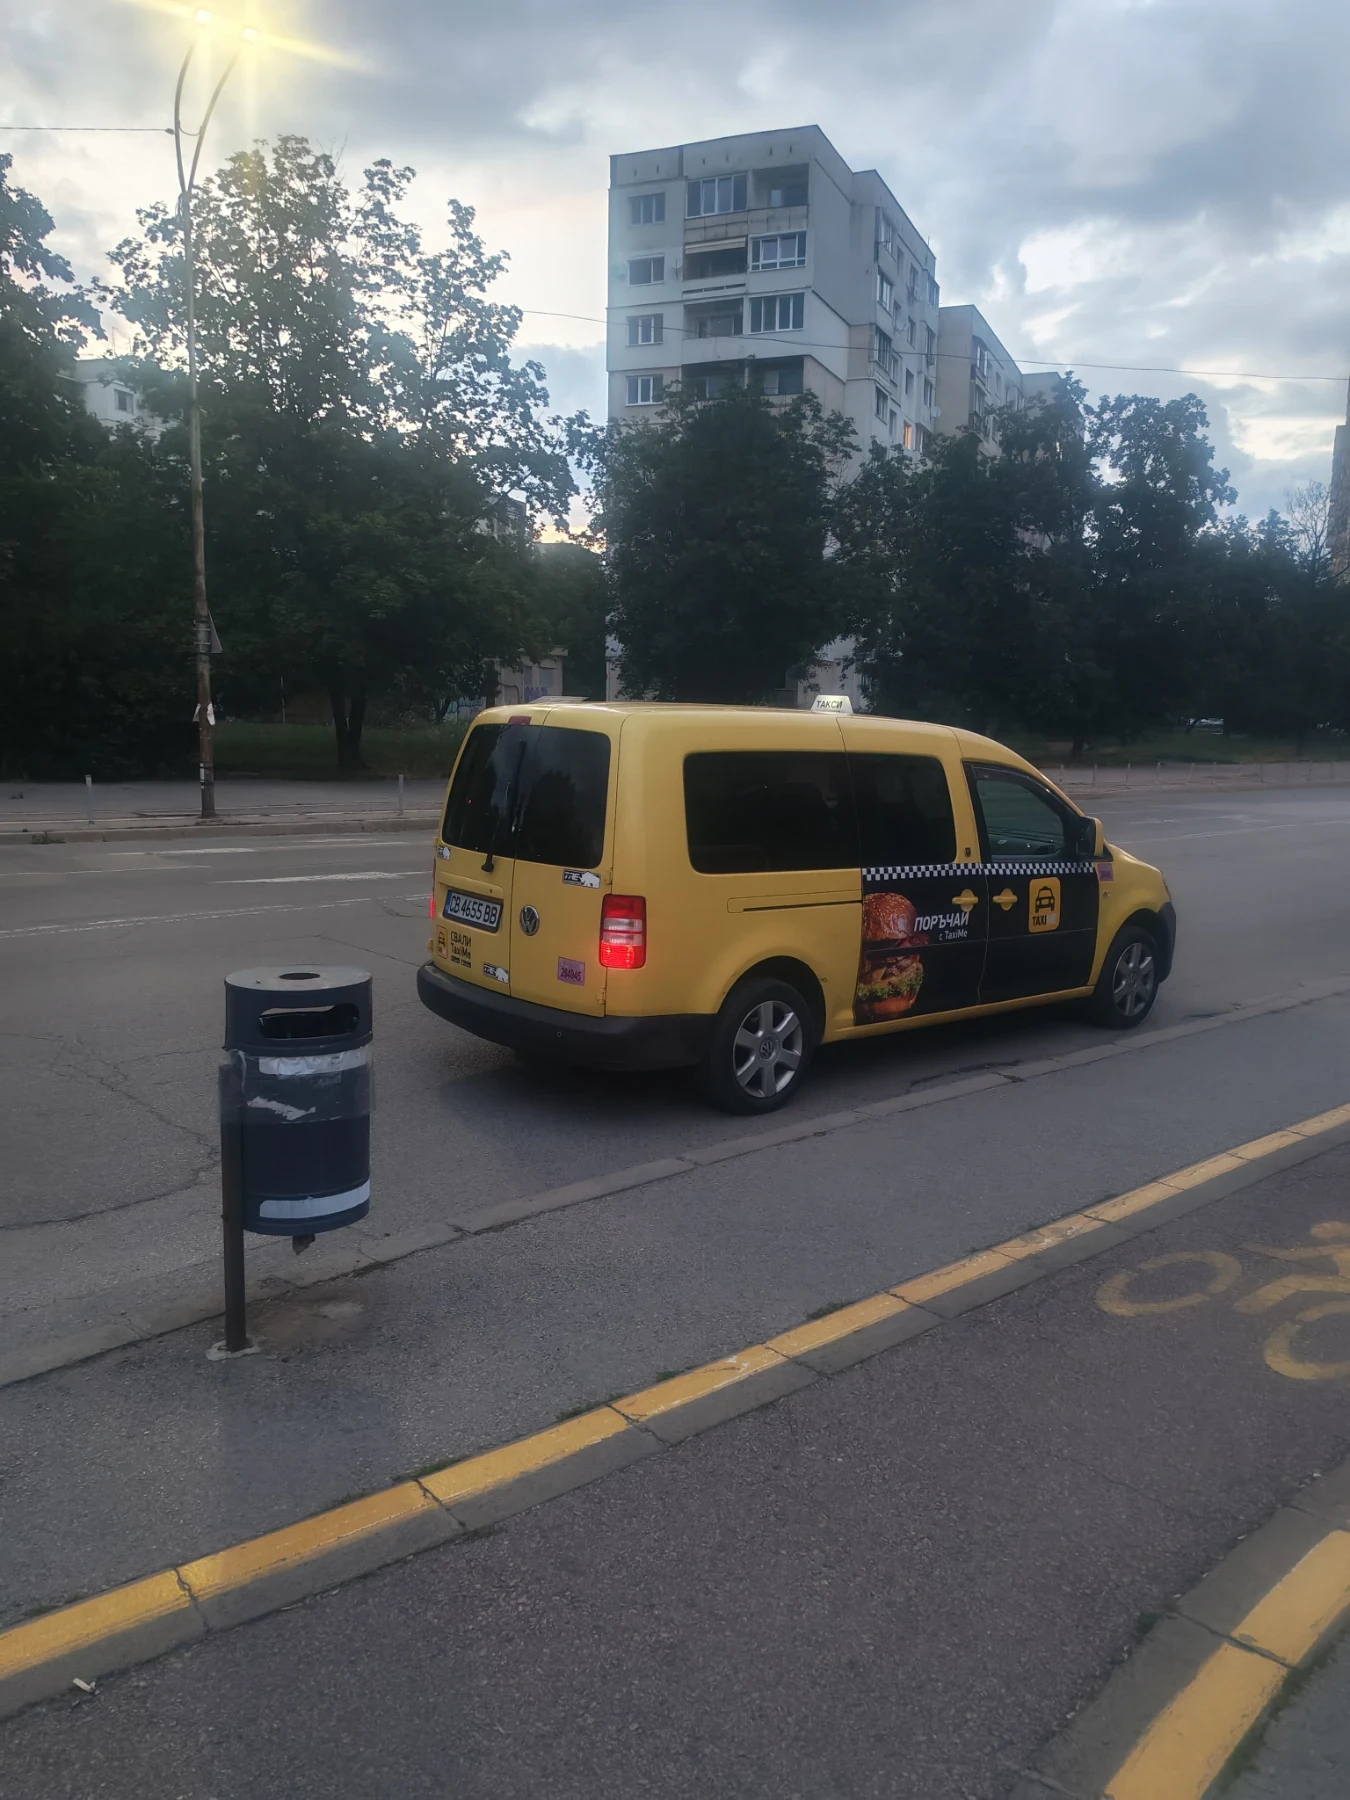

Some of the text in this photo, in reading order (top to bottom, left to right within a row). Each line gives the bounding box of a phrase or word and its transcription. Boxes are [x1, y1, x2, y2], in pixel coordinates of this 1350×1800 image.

[816, 700, 843, 708] ТАКСИ
[461, 898, 483, 920] 4655
[450, 931, 471, 948] СВАЛИ
